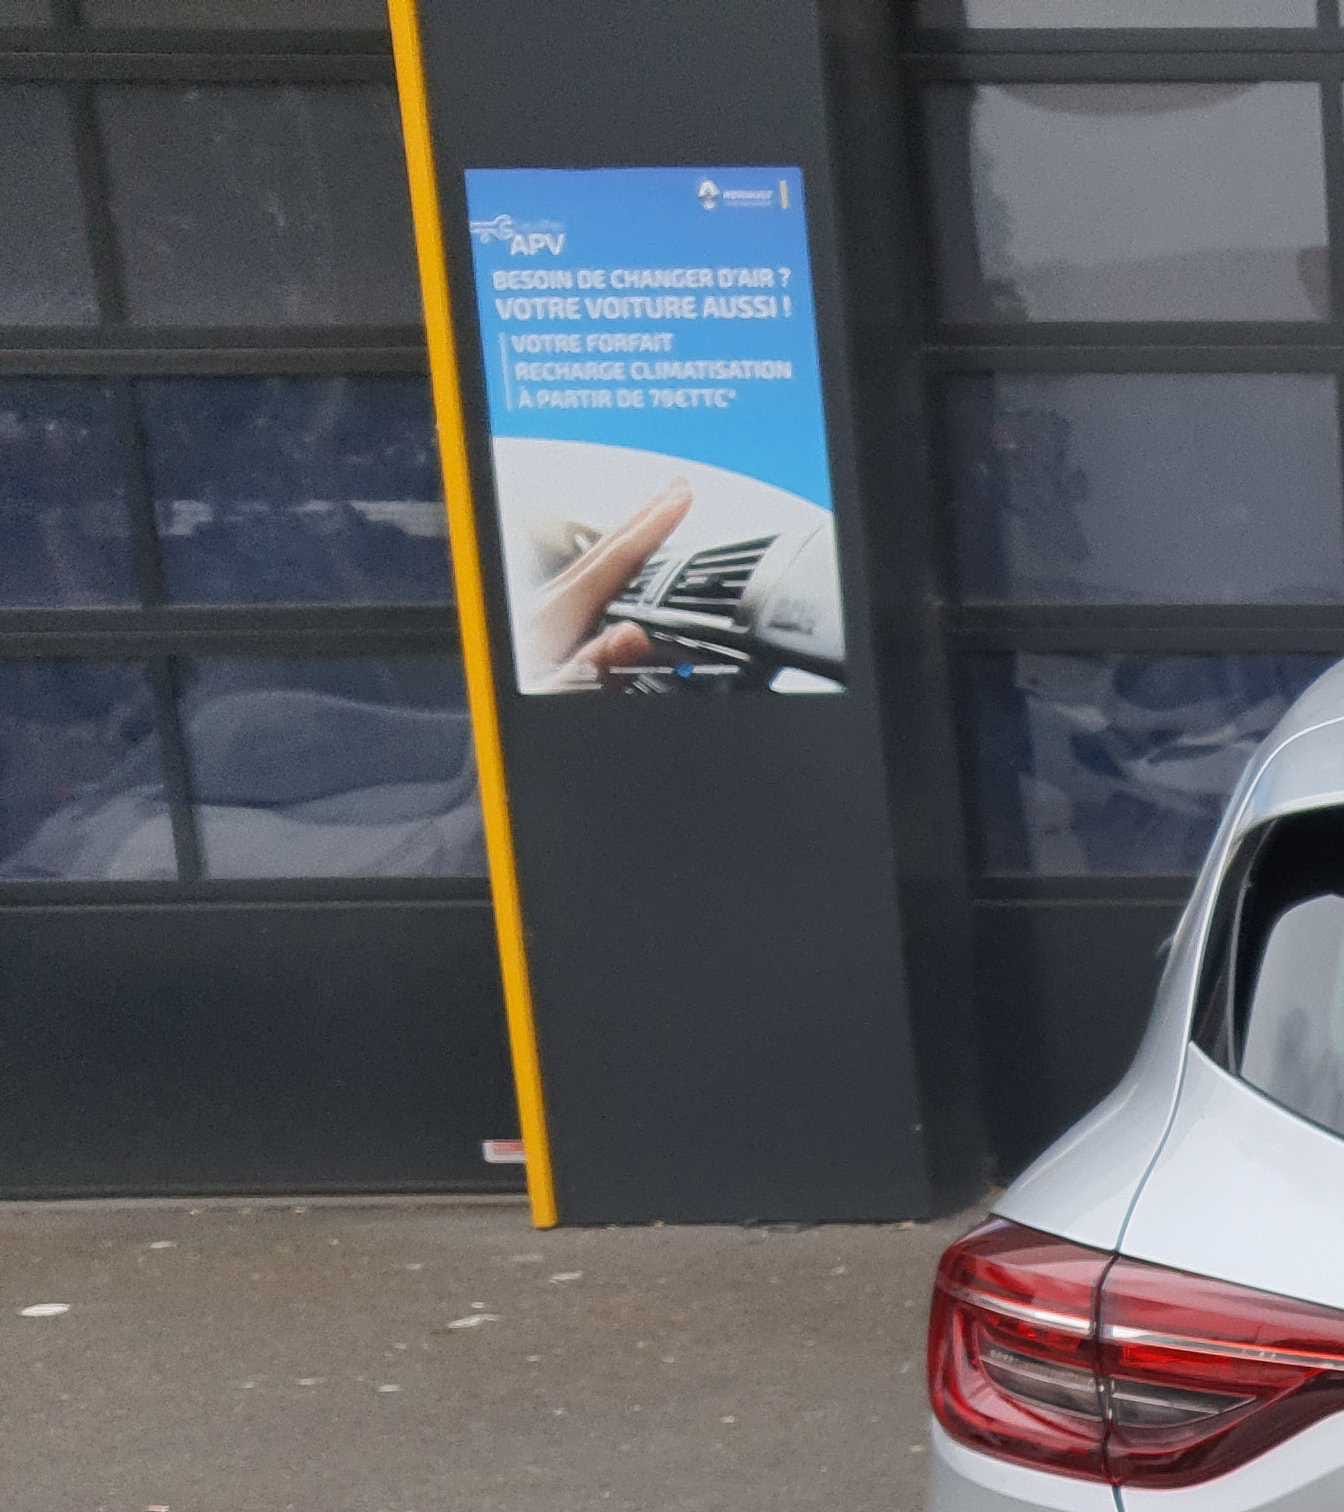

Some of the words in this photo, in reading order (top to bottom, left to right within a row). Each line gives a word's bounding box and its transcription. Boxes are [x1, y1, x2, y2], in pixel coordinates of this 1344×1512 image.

[510, 233, 566, 256] APV
[493, 269, 573, 291] BESOIN
[576, 269, 606, 290] DE
[610, 268, 714, 290] CHANGER
[717, 267, 775, 289] D'AIR
[495, 296, 582, 321] VOTRE
[583, 295, 698, 320] VOITURE
[703, 295, 778, 320] AUSSI
[511, 333, 581, 353] VOTRE
[586, 332, 673, 353] FORFAIT
[514, 360, 625, 382] RECHARGE
[630, 359, 792, 381] CLIMATISATION
[536, 388, 613, 409] PARTIR
[616, 388, 646, 408] DE
